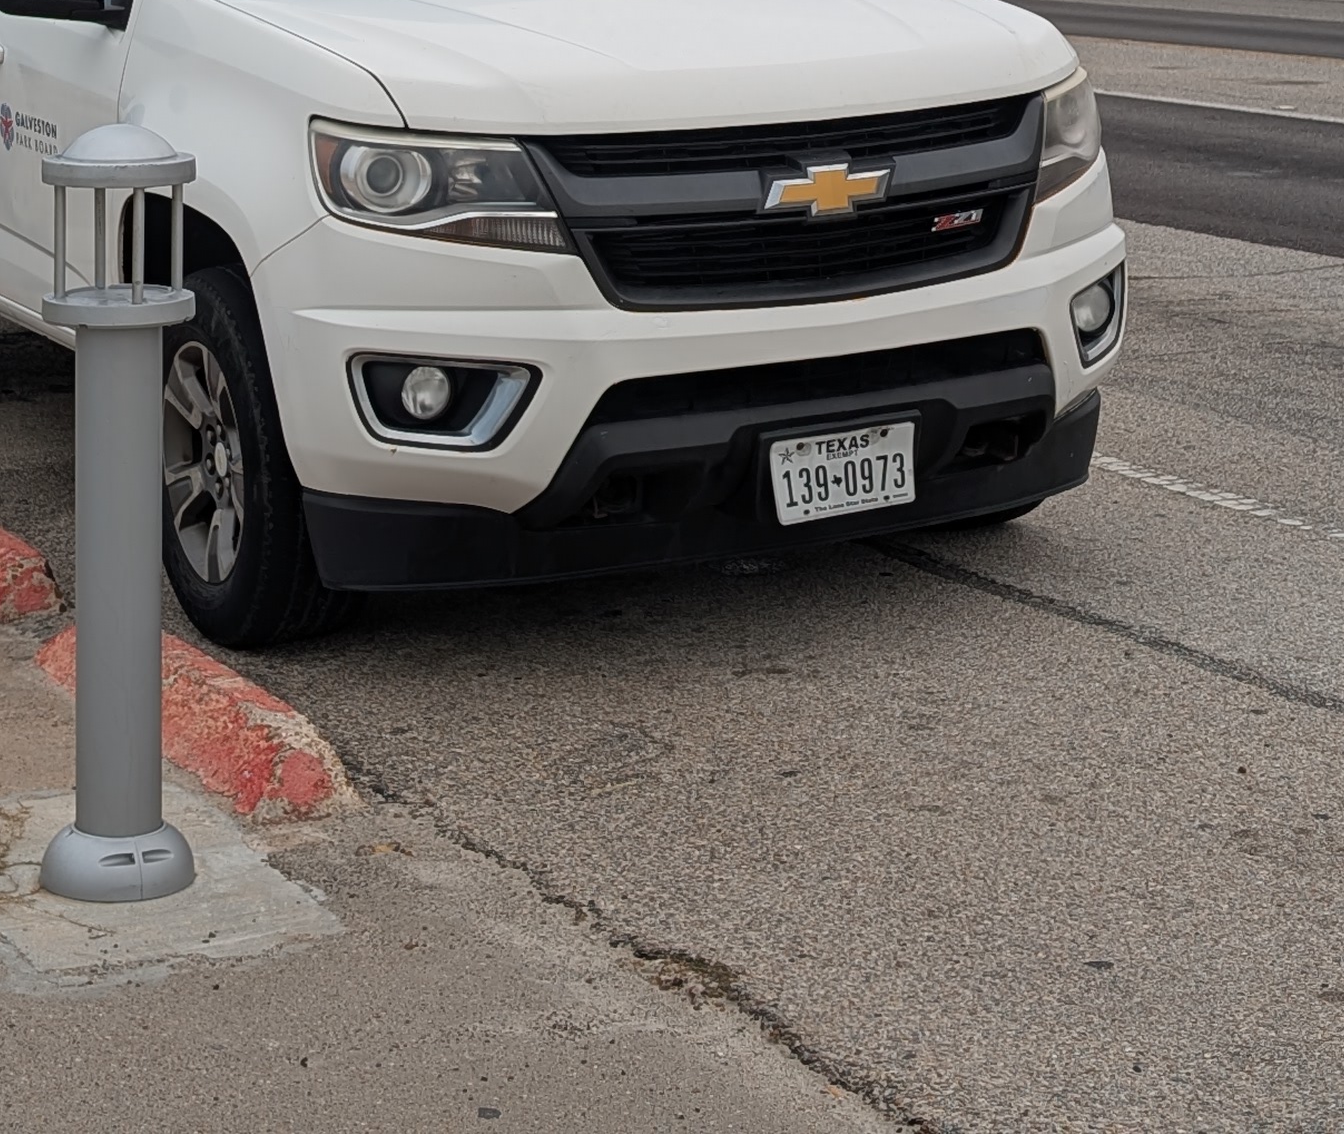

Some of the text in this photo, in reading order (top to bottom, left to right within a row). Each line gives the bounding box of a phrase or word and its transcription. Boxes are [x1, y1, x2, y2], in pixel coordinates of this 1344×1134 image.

[15, 111, 57, 139] GALVESTON
[16, 132, 58, 156] PARK BOARD
[815, 434, 870, 455] TEXAS
[826, 449, 859, 460] EXEMPT
